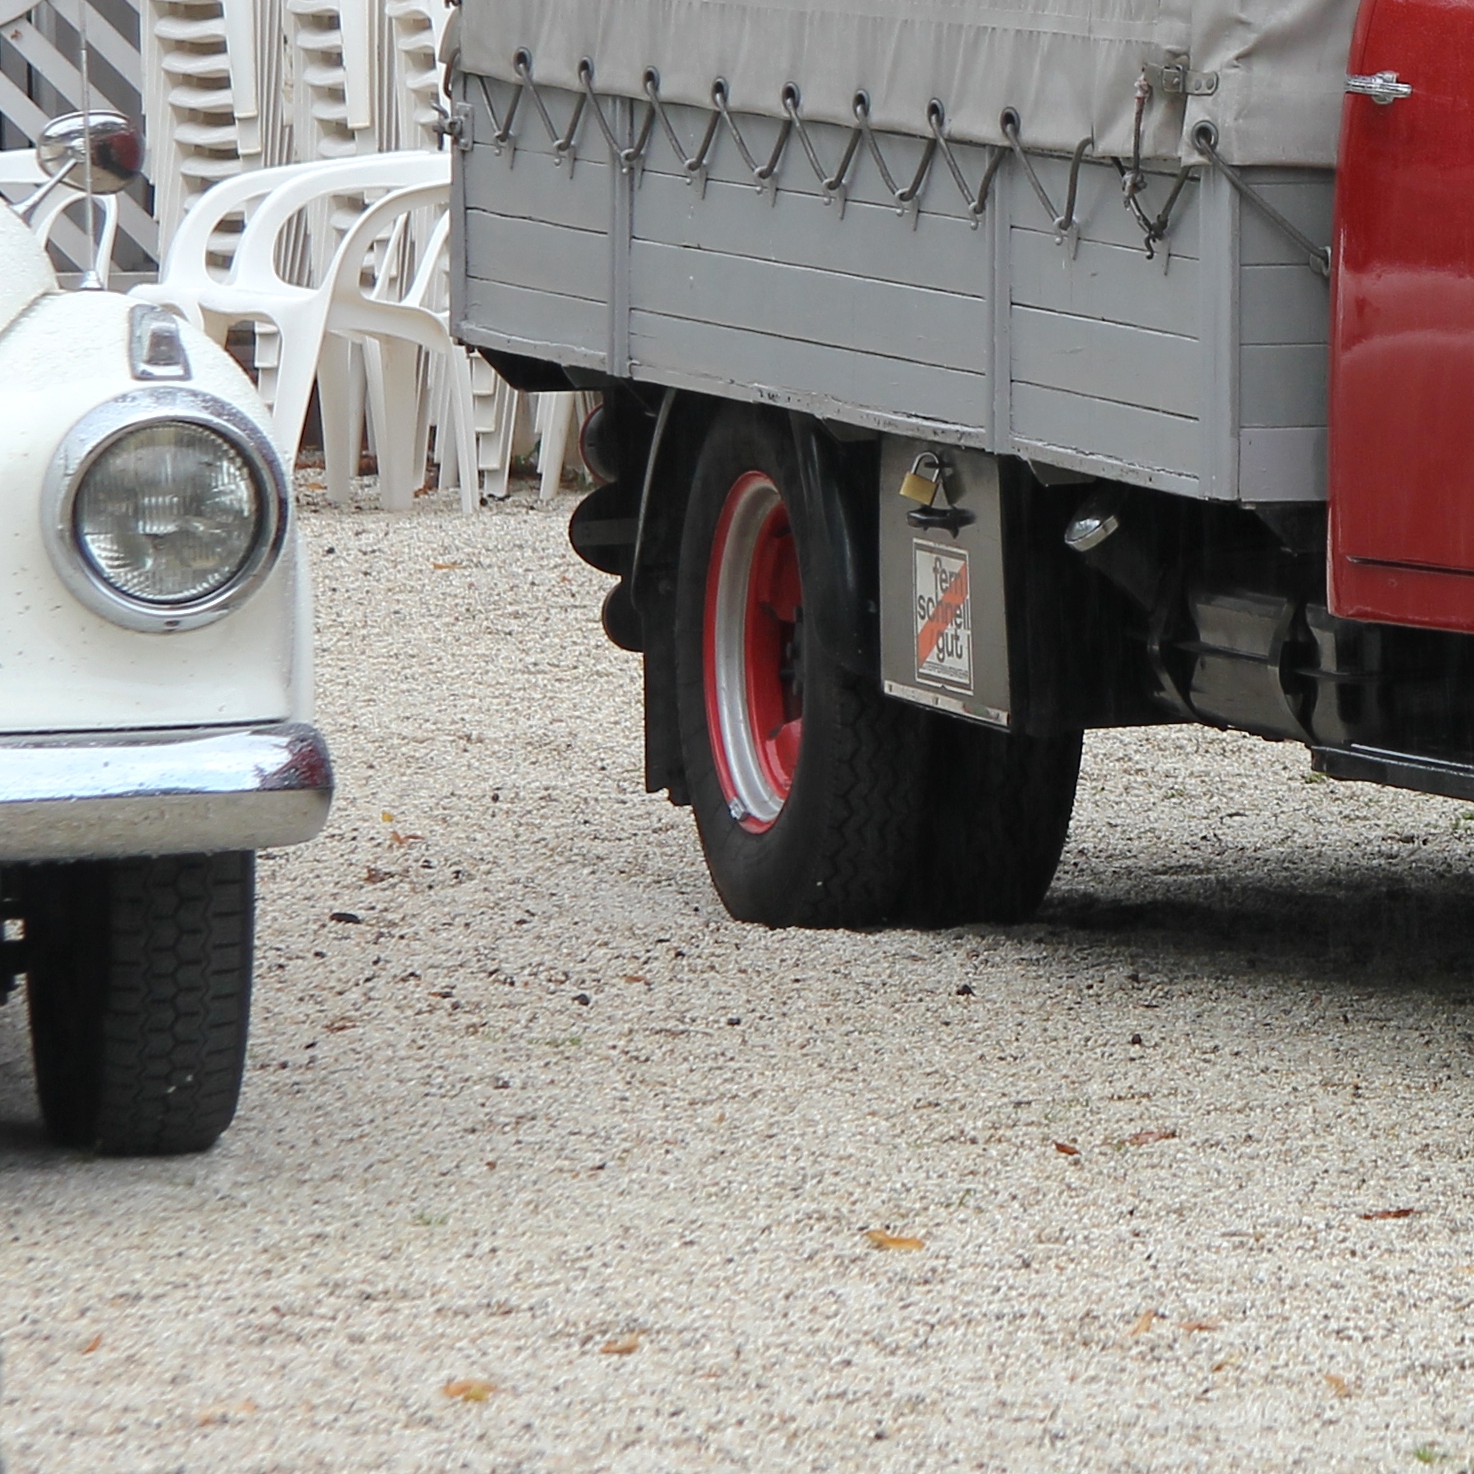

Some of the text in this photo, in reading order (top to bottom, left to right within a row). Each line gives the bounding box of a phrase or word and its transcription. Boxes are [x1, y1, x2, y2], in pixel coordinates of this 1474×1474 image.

[932, 556, 967, 597] fern
[917, 592, 971, 632] schnell
[936, 628, 964, 664] gut
